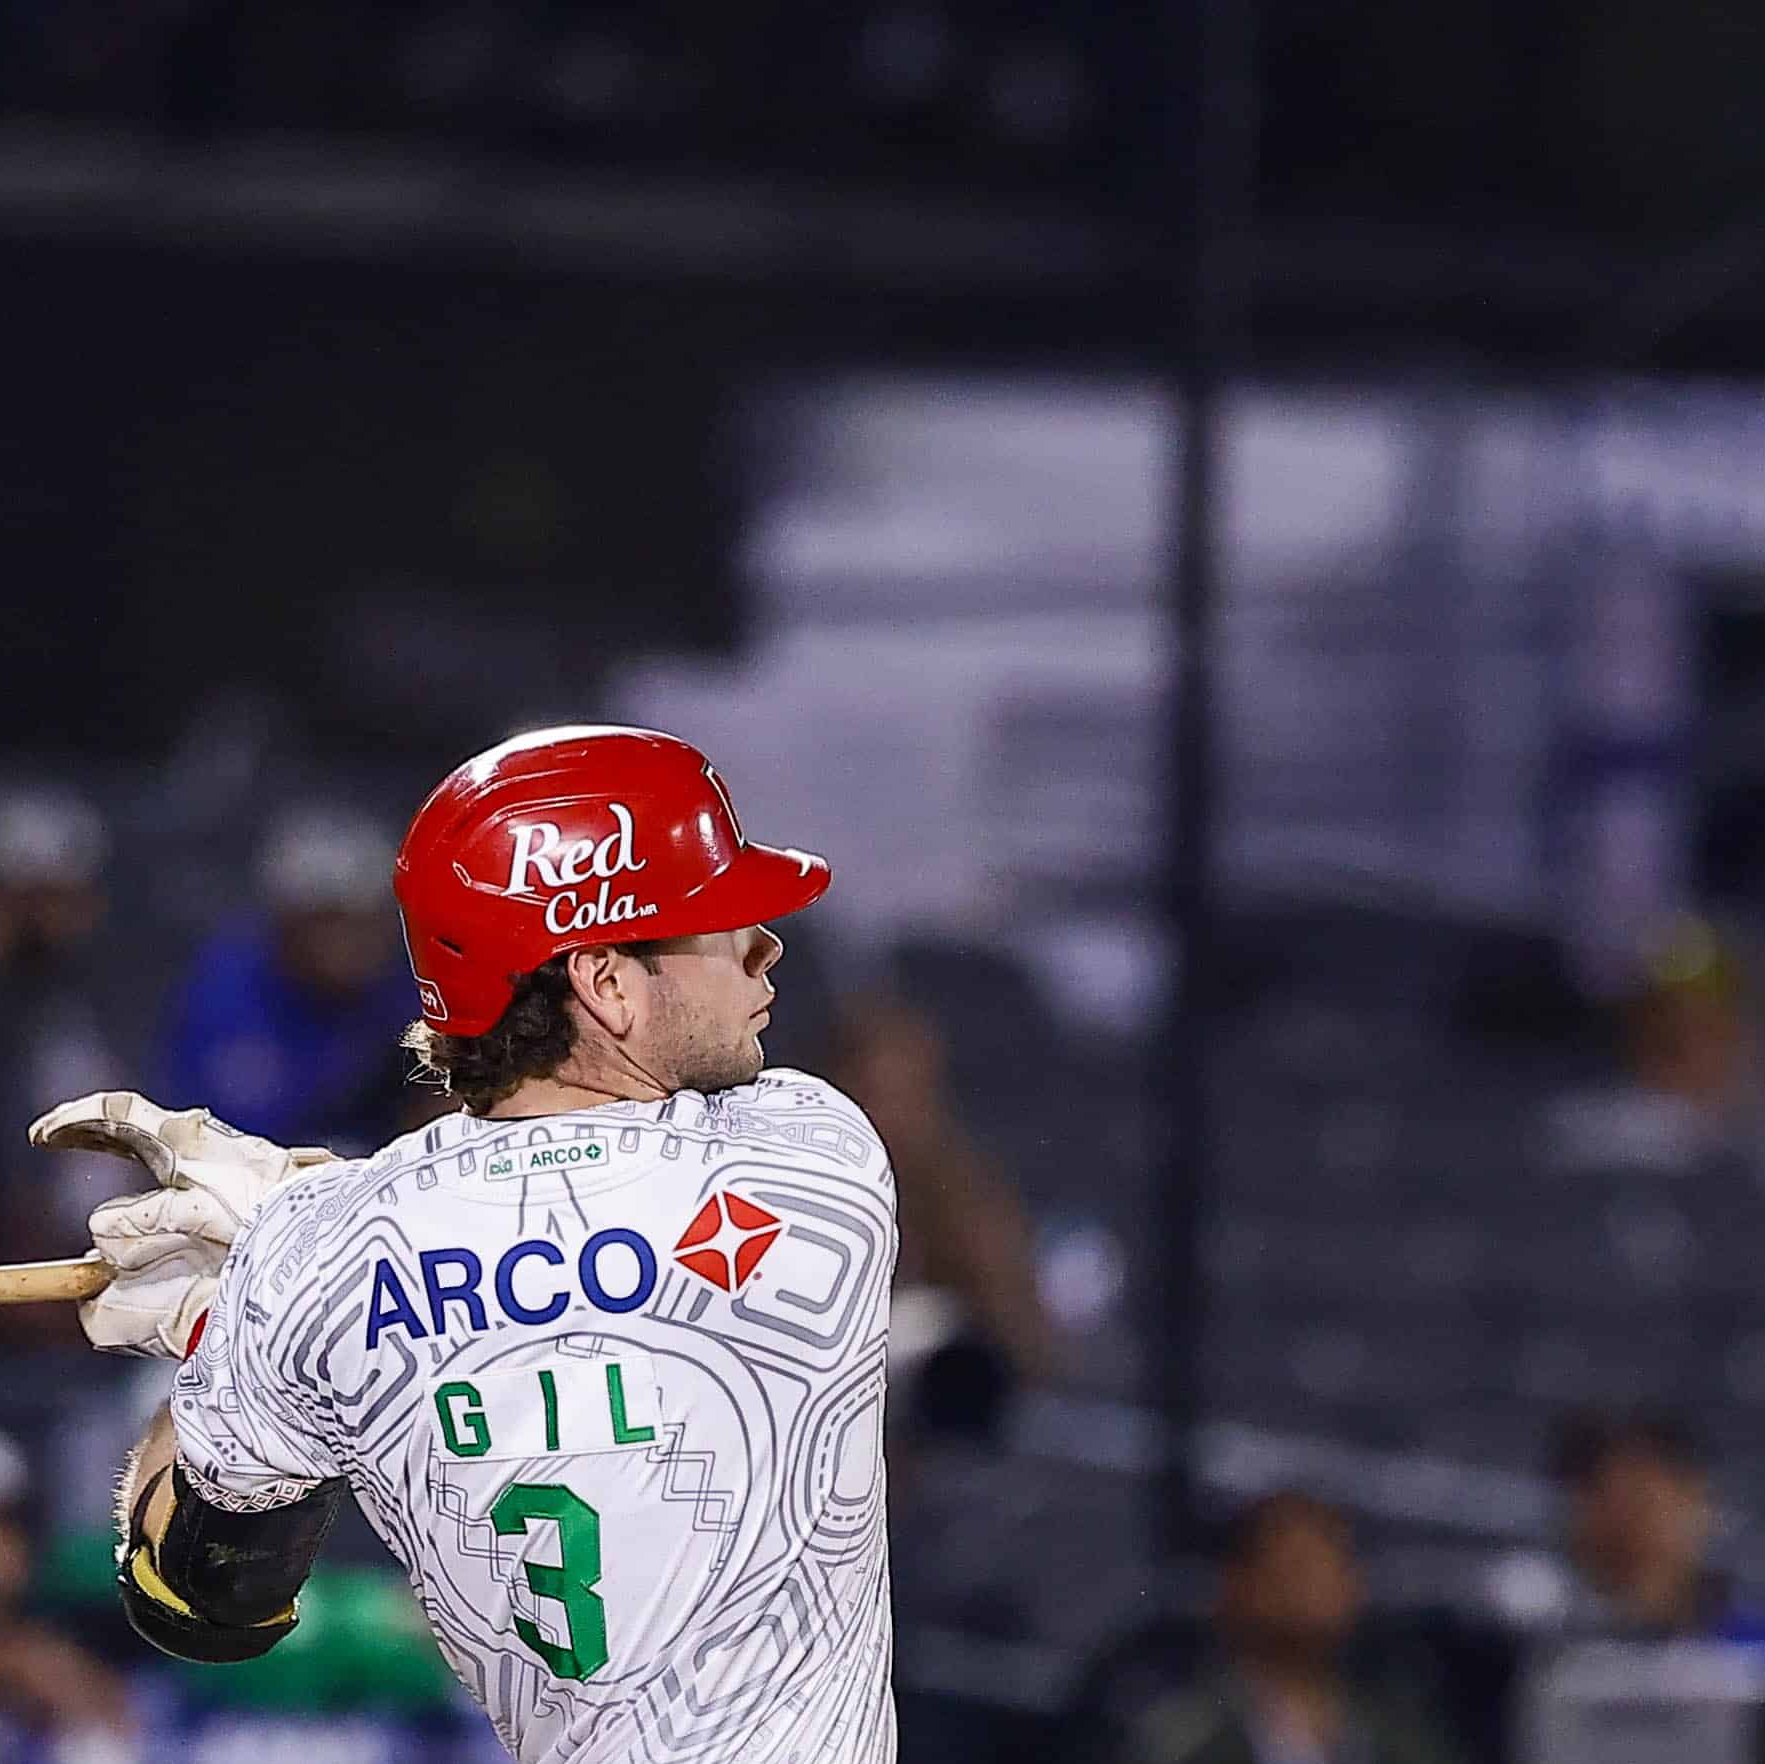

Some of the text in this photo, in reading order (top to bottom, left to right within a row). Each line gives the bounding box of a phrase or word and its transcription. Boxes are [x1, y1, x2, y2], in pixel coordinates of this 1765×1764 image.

[500, 803, 647, 896] Red
[545, 881, 639, 934] Cola
[529, 1146, 582, 1168] ARCO
[365, 1228, 657, 1351] ARCO
[436, 1363, 655, 1457] GIL
[491, 1483, 608, 1682] 3
